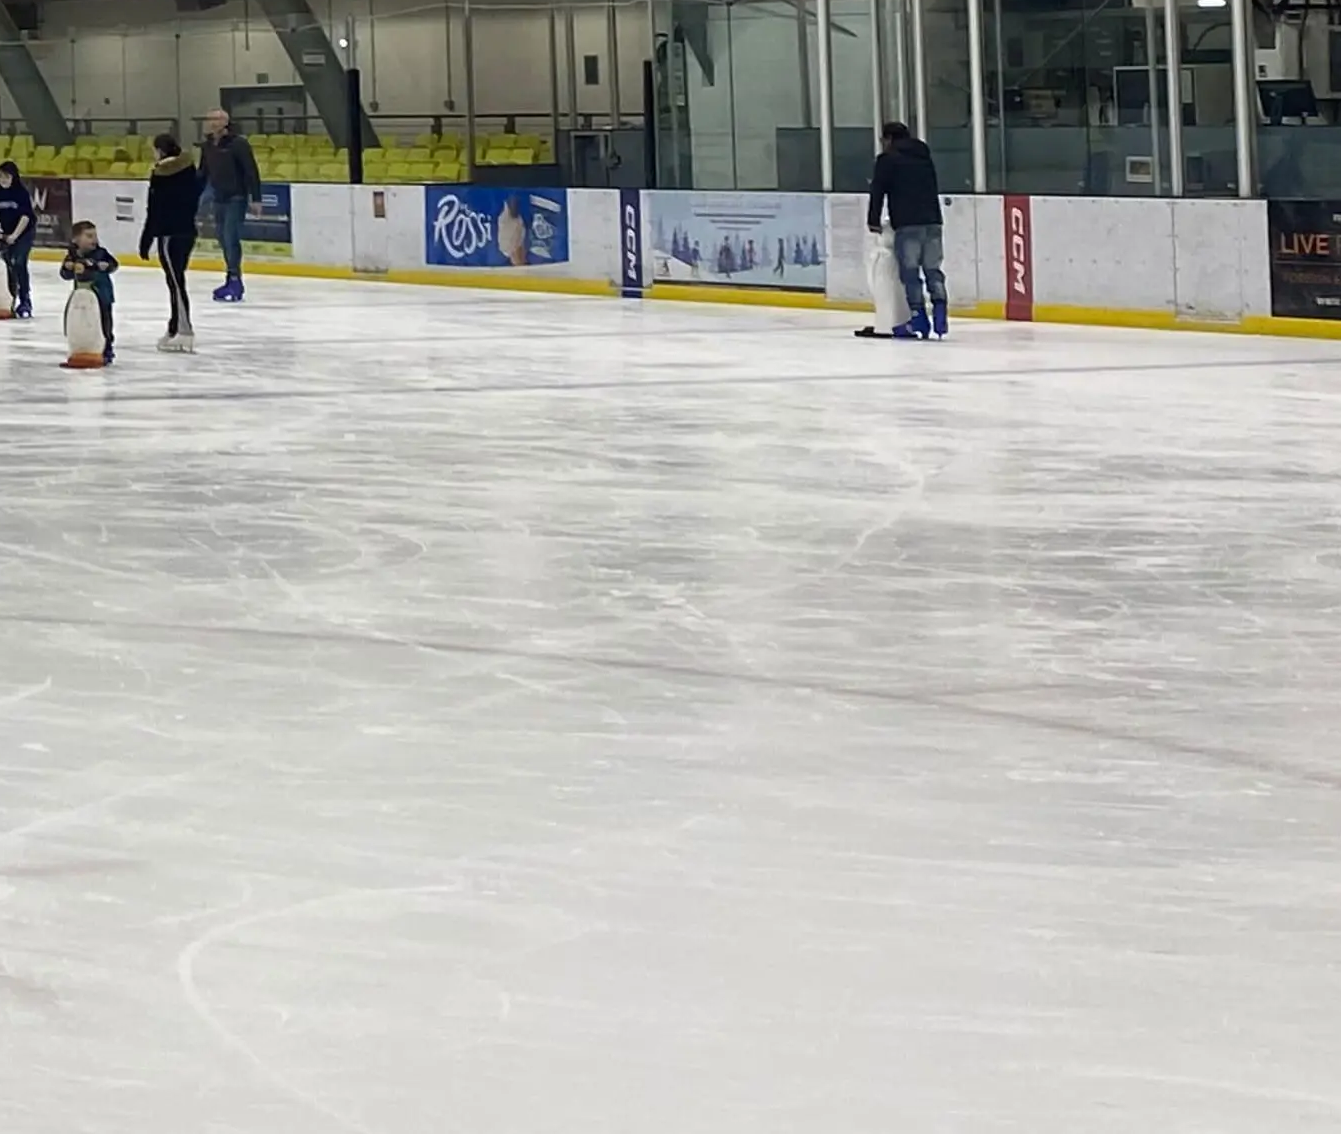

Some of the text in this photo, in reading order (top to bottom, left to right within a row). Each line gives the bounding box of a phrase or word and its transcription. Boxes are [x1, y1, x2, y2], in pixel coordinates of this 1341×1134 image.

[625, 204, 637, 281] CCM
[1011, 207, 1025, 294] CCM
[1280, 232, 1330, 255] LIVE
